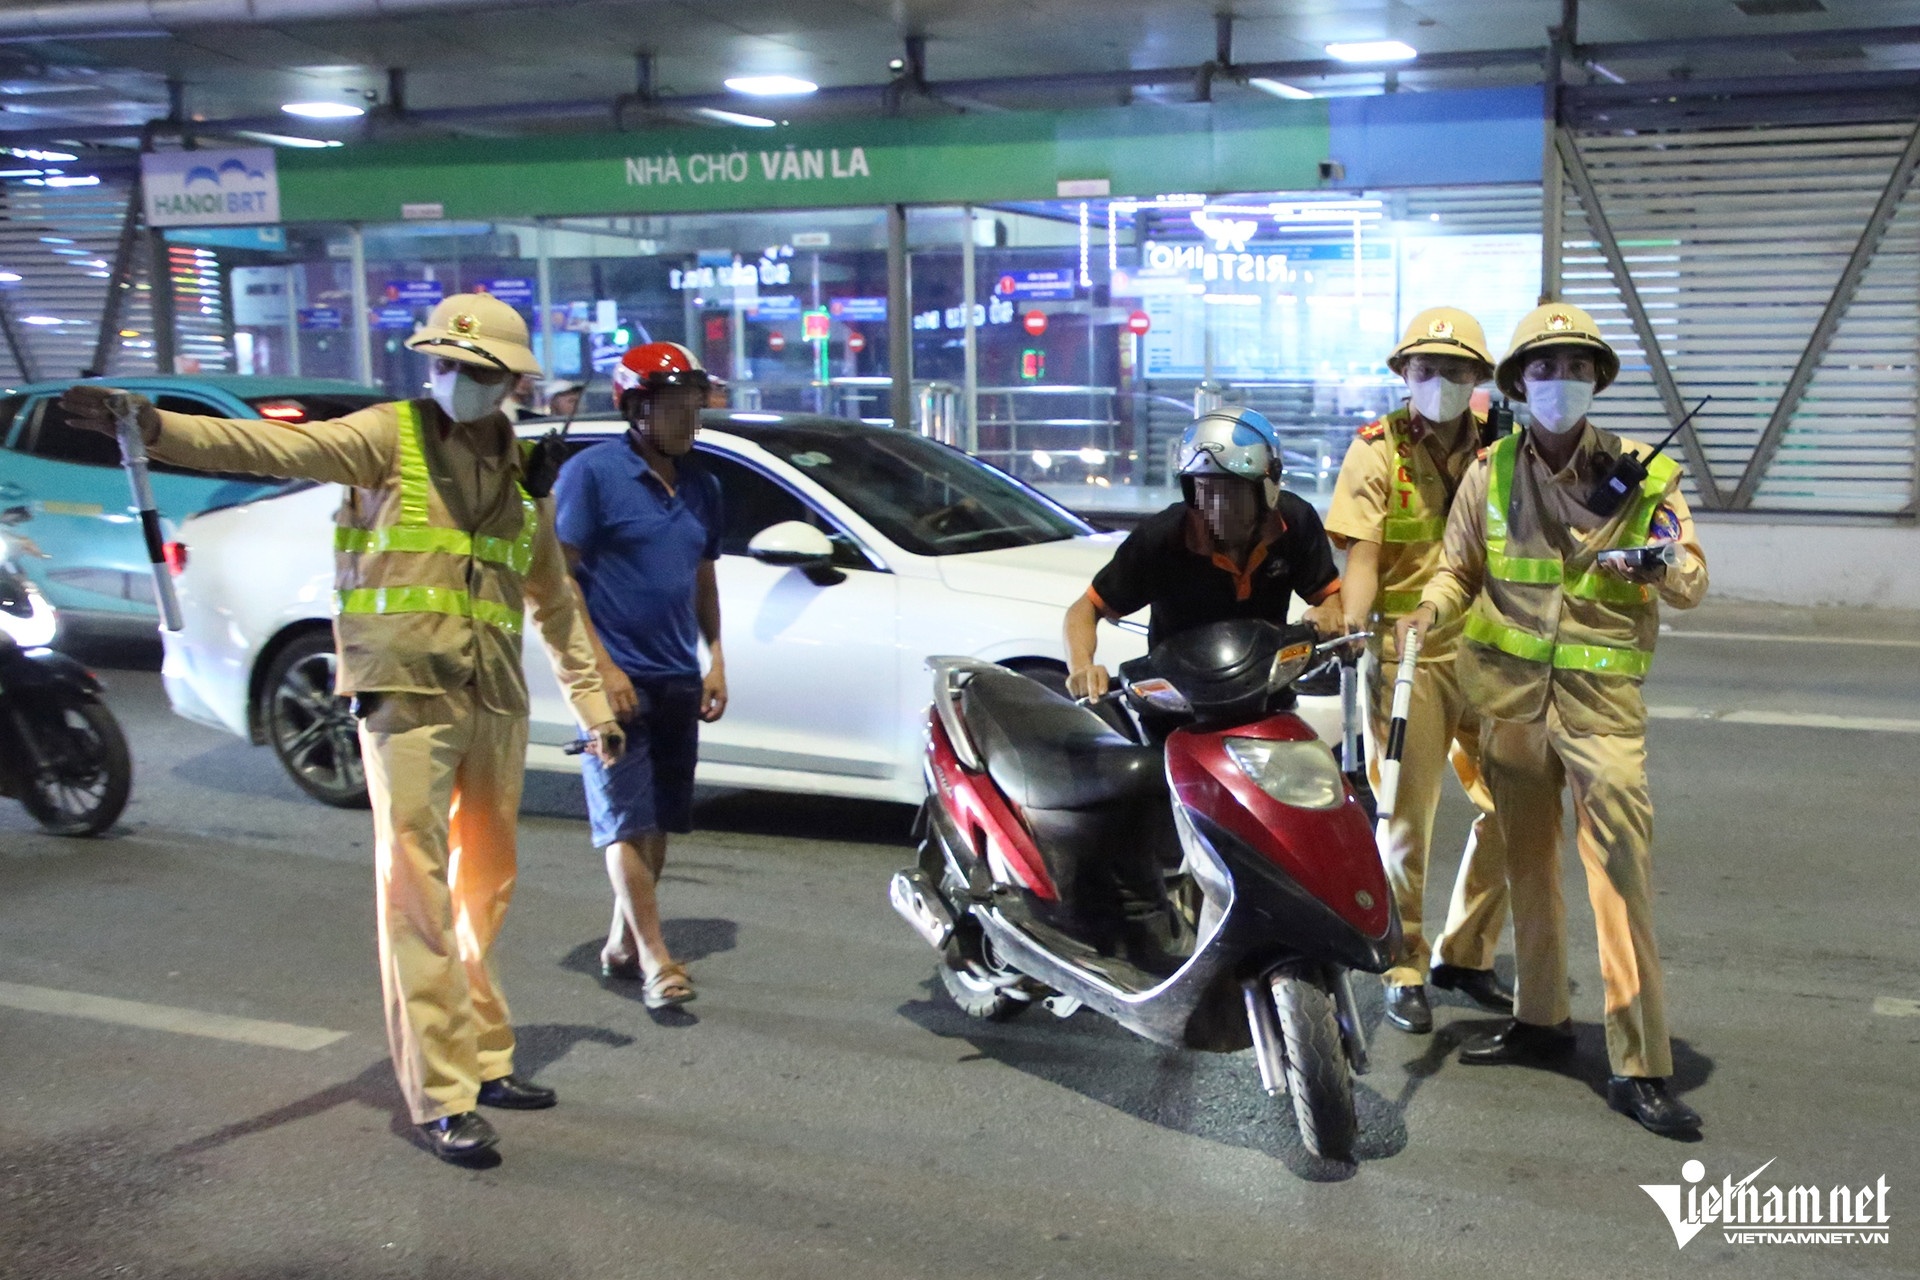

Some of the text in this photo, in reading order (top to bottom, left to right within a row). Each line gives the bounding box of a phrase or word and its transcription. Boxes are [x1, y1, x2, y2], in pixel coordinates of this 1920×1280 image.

[760, 143, 824, 180] VĂN
[831, 148, 870, 178] LA
[153, 191, 266, 216] HANOI BRT
